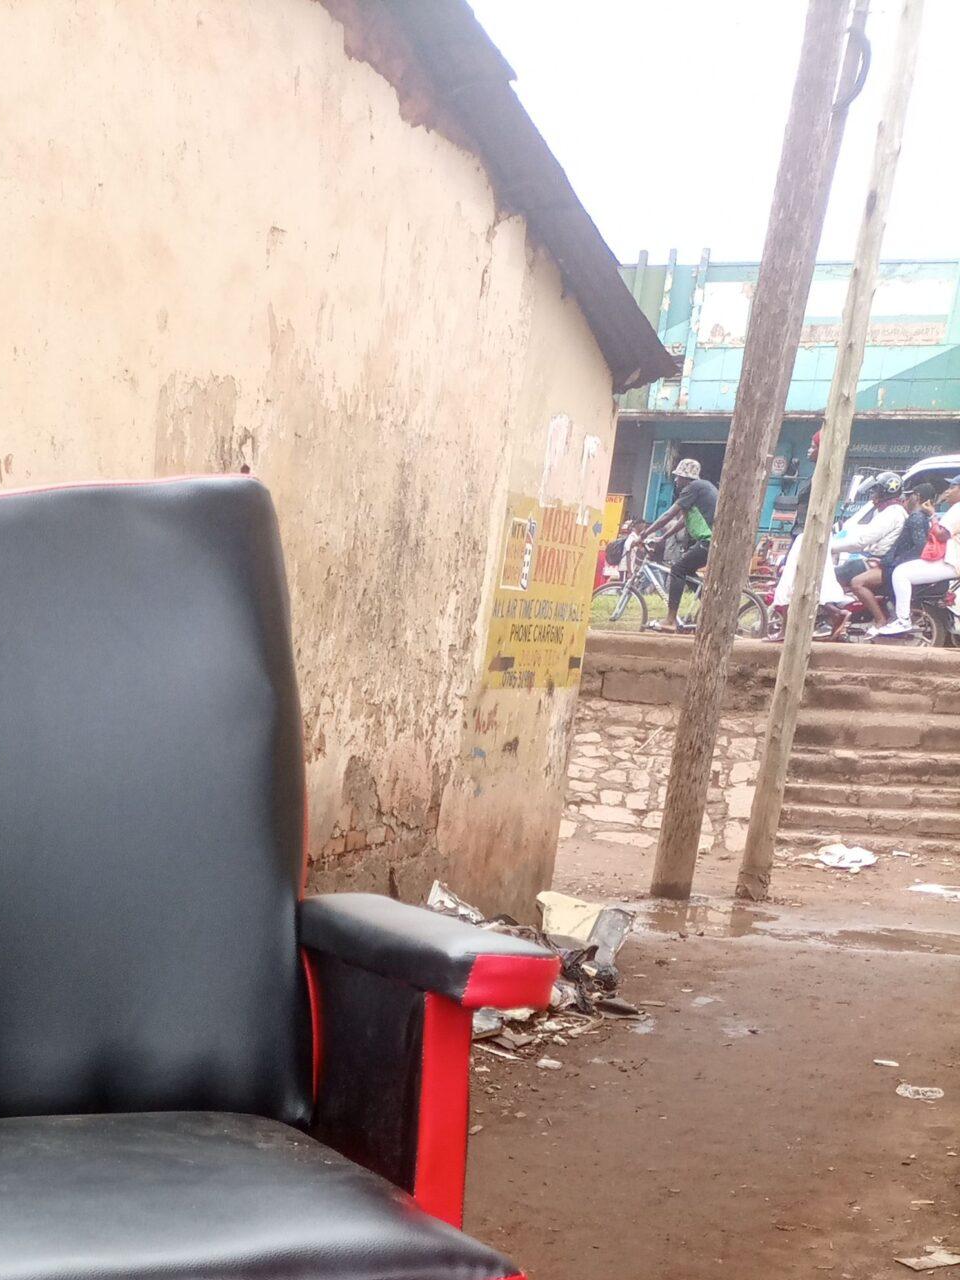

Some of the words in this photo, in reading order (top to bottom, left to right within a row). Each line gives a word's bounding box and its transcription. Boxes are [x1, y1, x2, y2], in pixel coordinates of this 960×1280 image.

[532, 545, 584, 587] MONEY
[509, 623, 533, 642] PHONE
[533, 623, 564, 644] CHARGING
